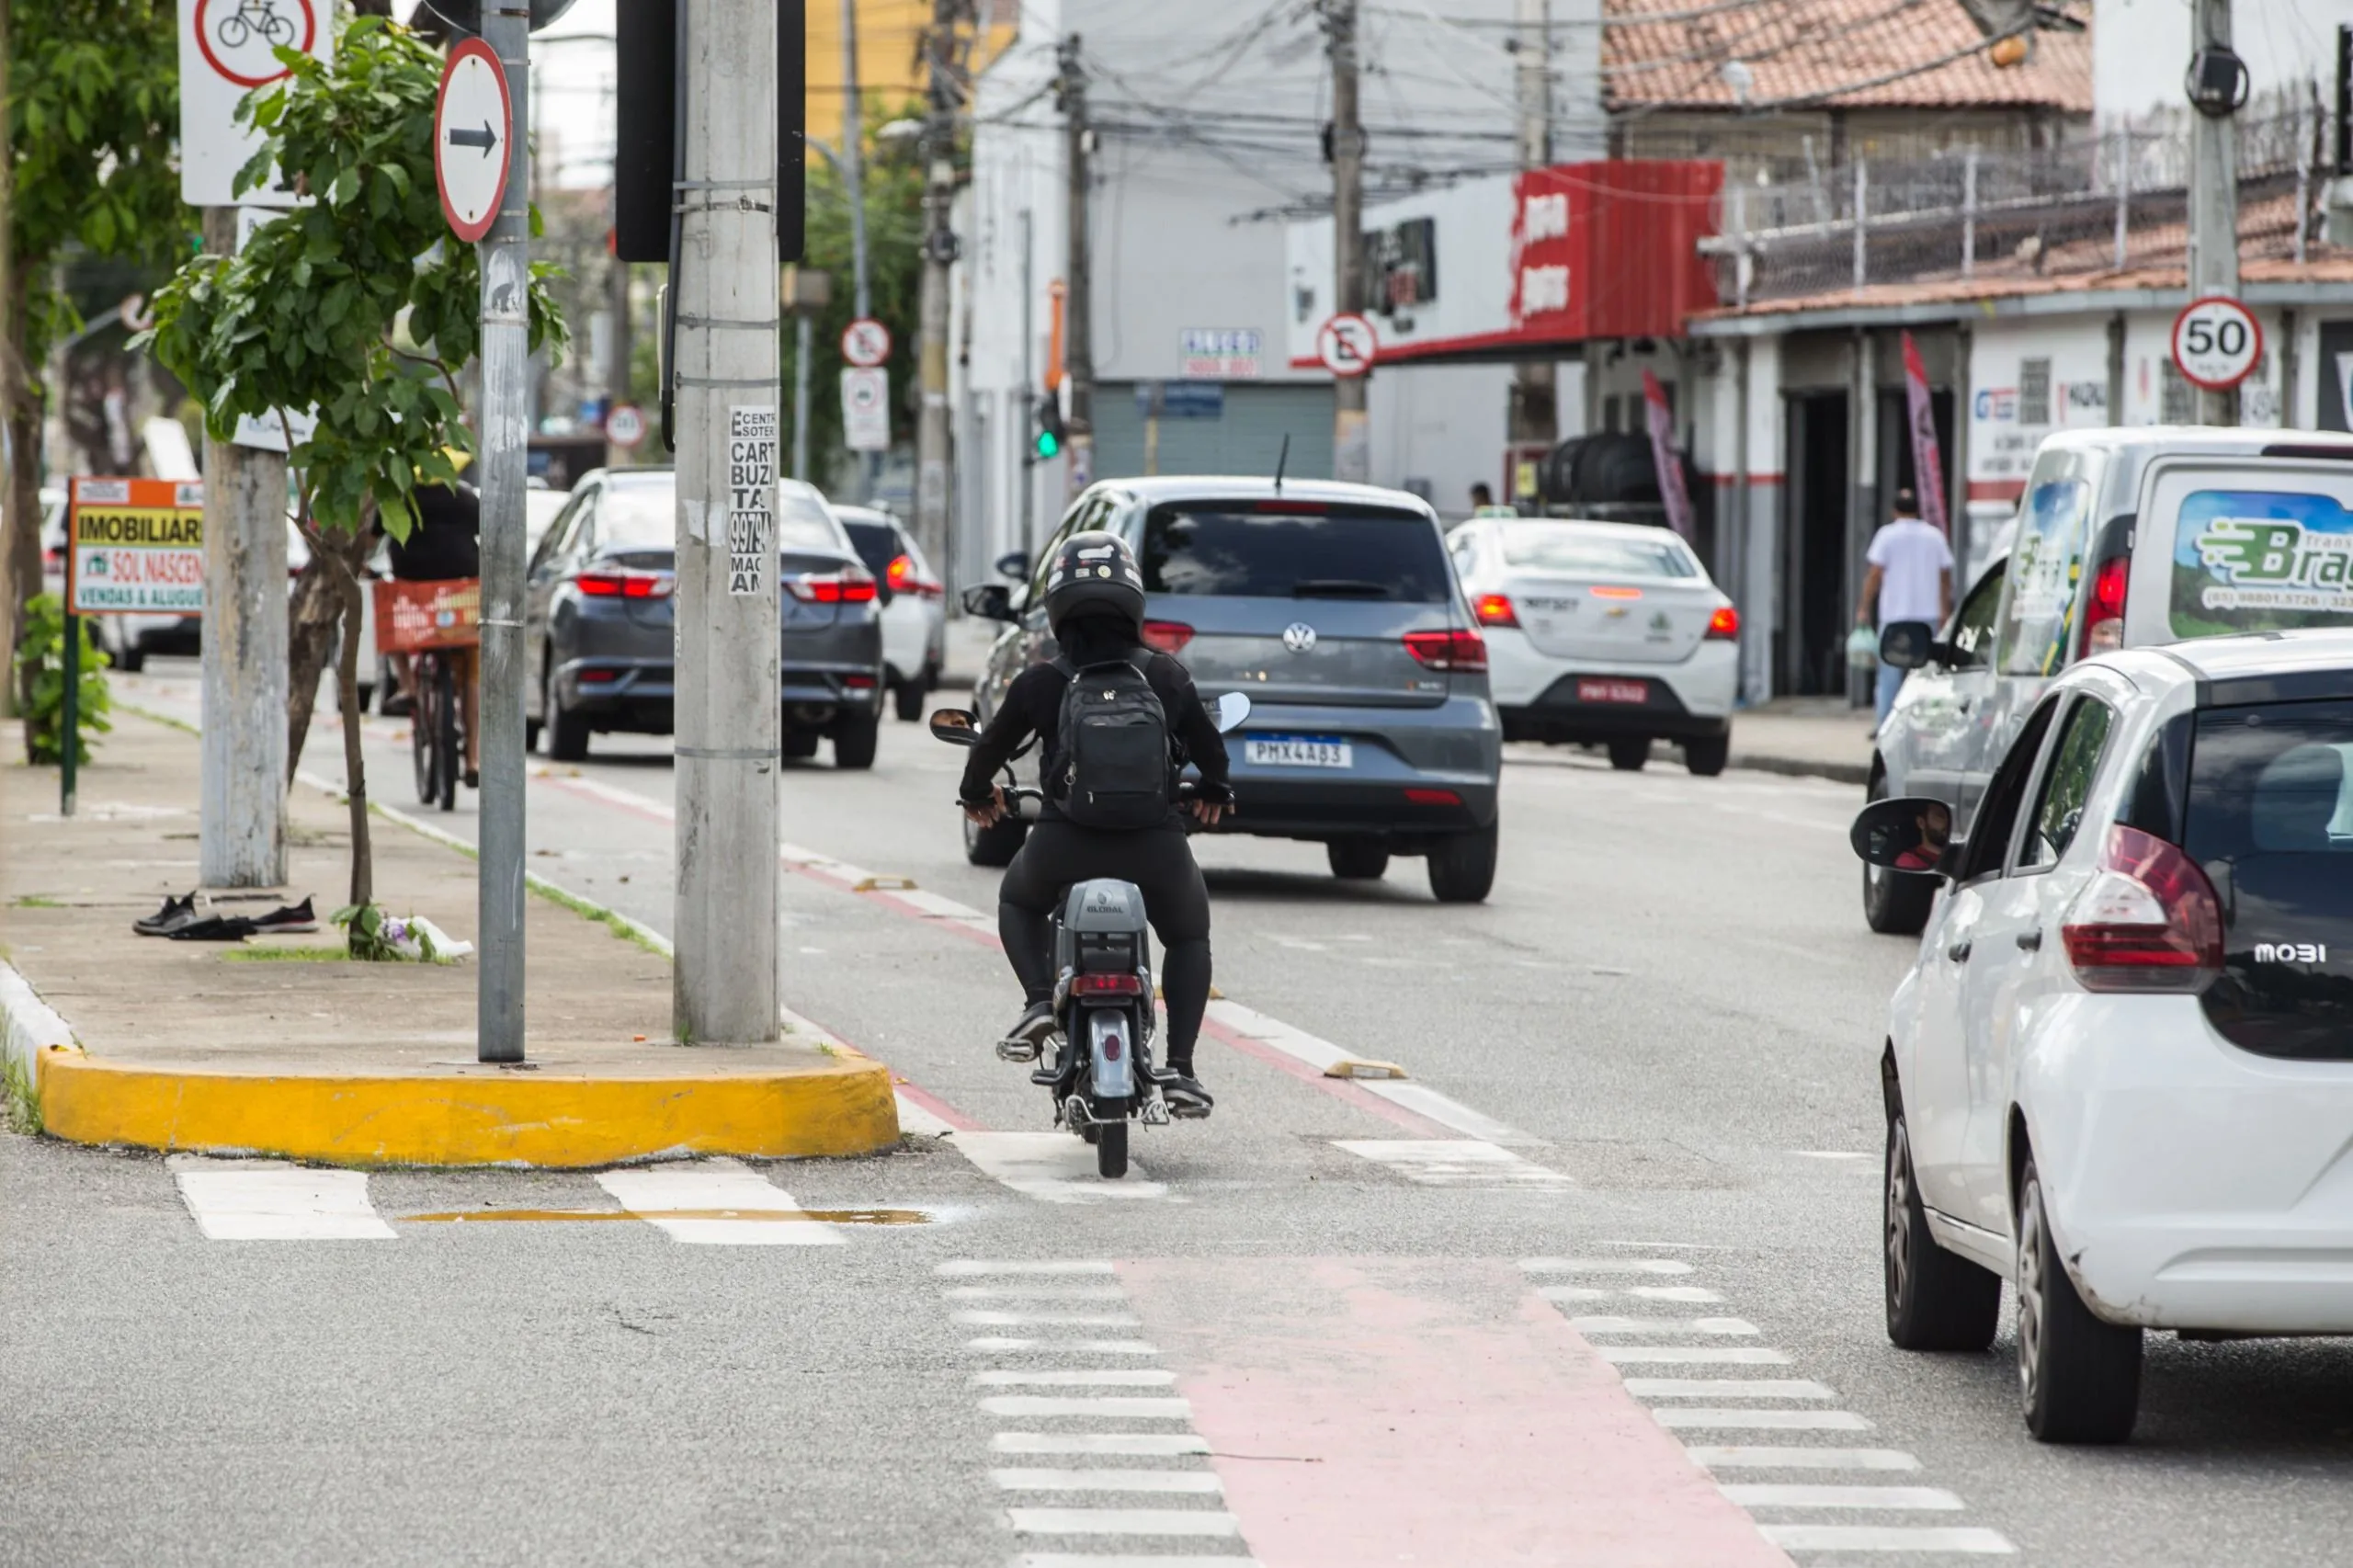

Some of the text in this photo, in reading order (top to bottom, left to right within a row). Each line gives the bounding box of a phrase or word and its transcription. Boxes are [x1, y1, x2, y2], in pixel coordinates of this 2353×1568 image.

[2187, 319, 2246, 356] 50
[113, 552, 141, 583] SOL
[2201, 523, 2353, 589] Bra
[79, 588, 132, 605] VENDAS
